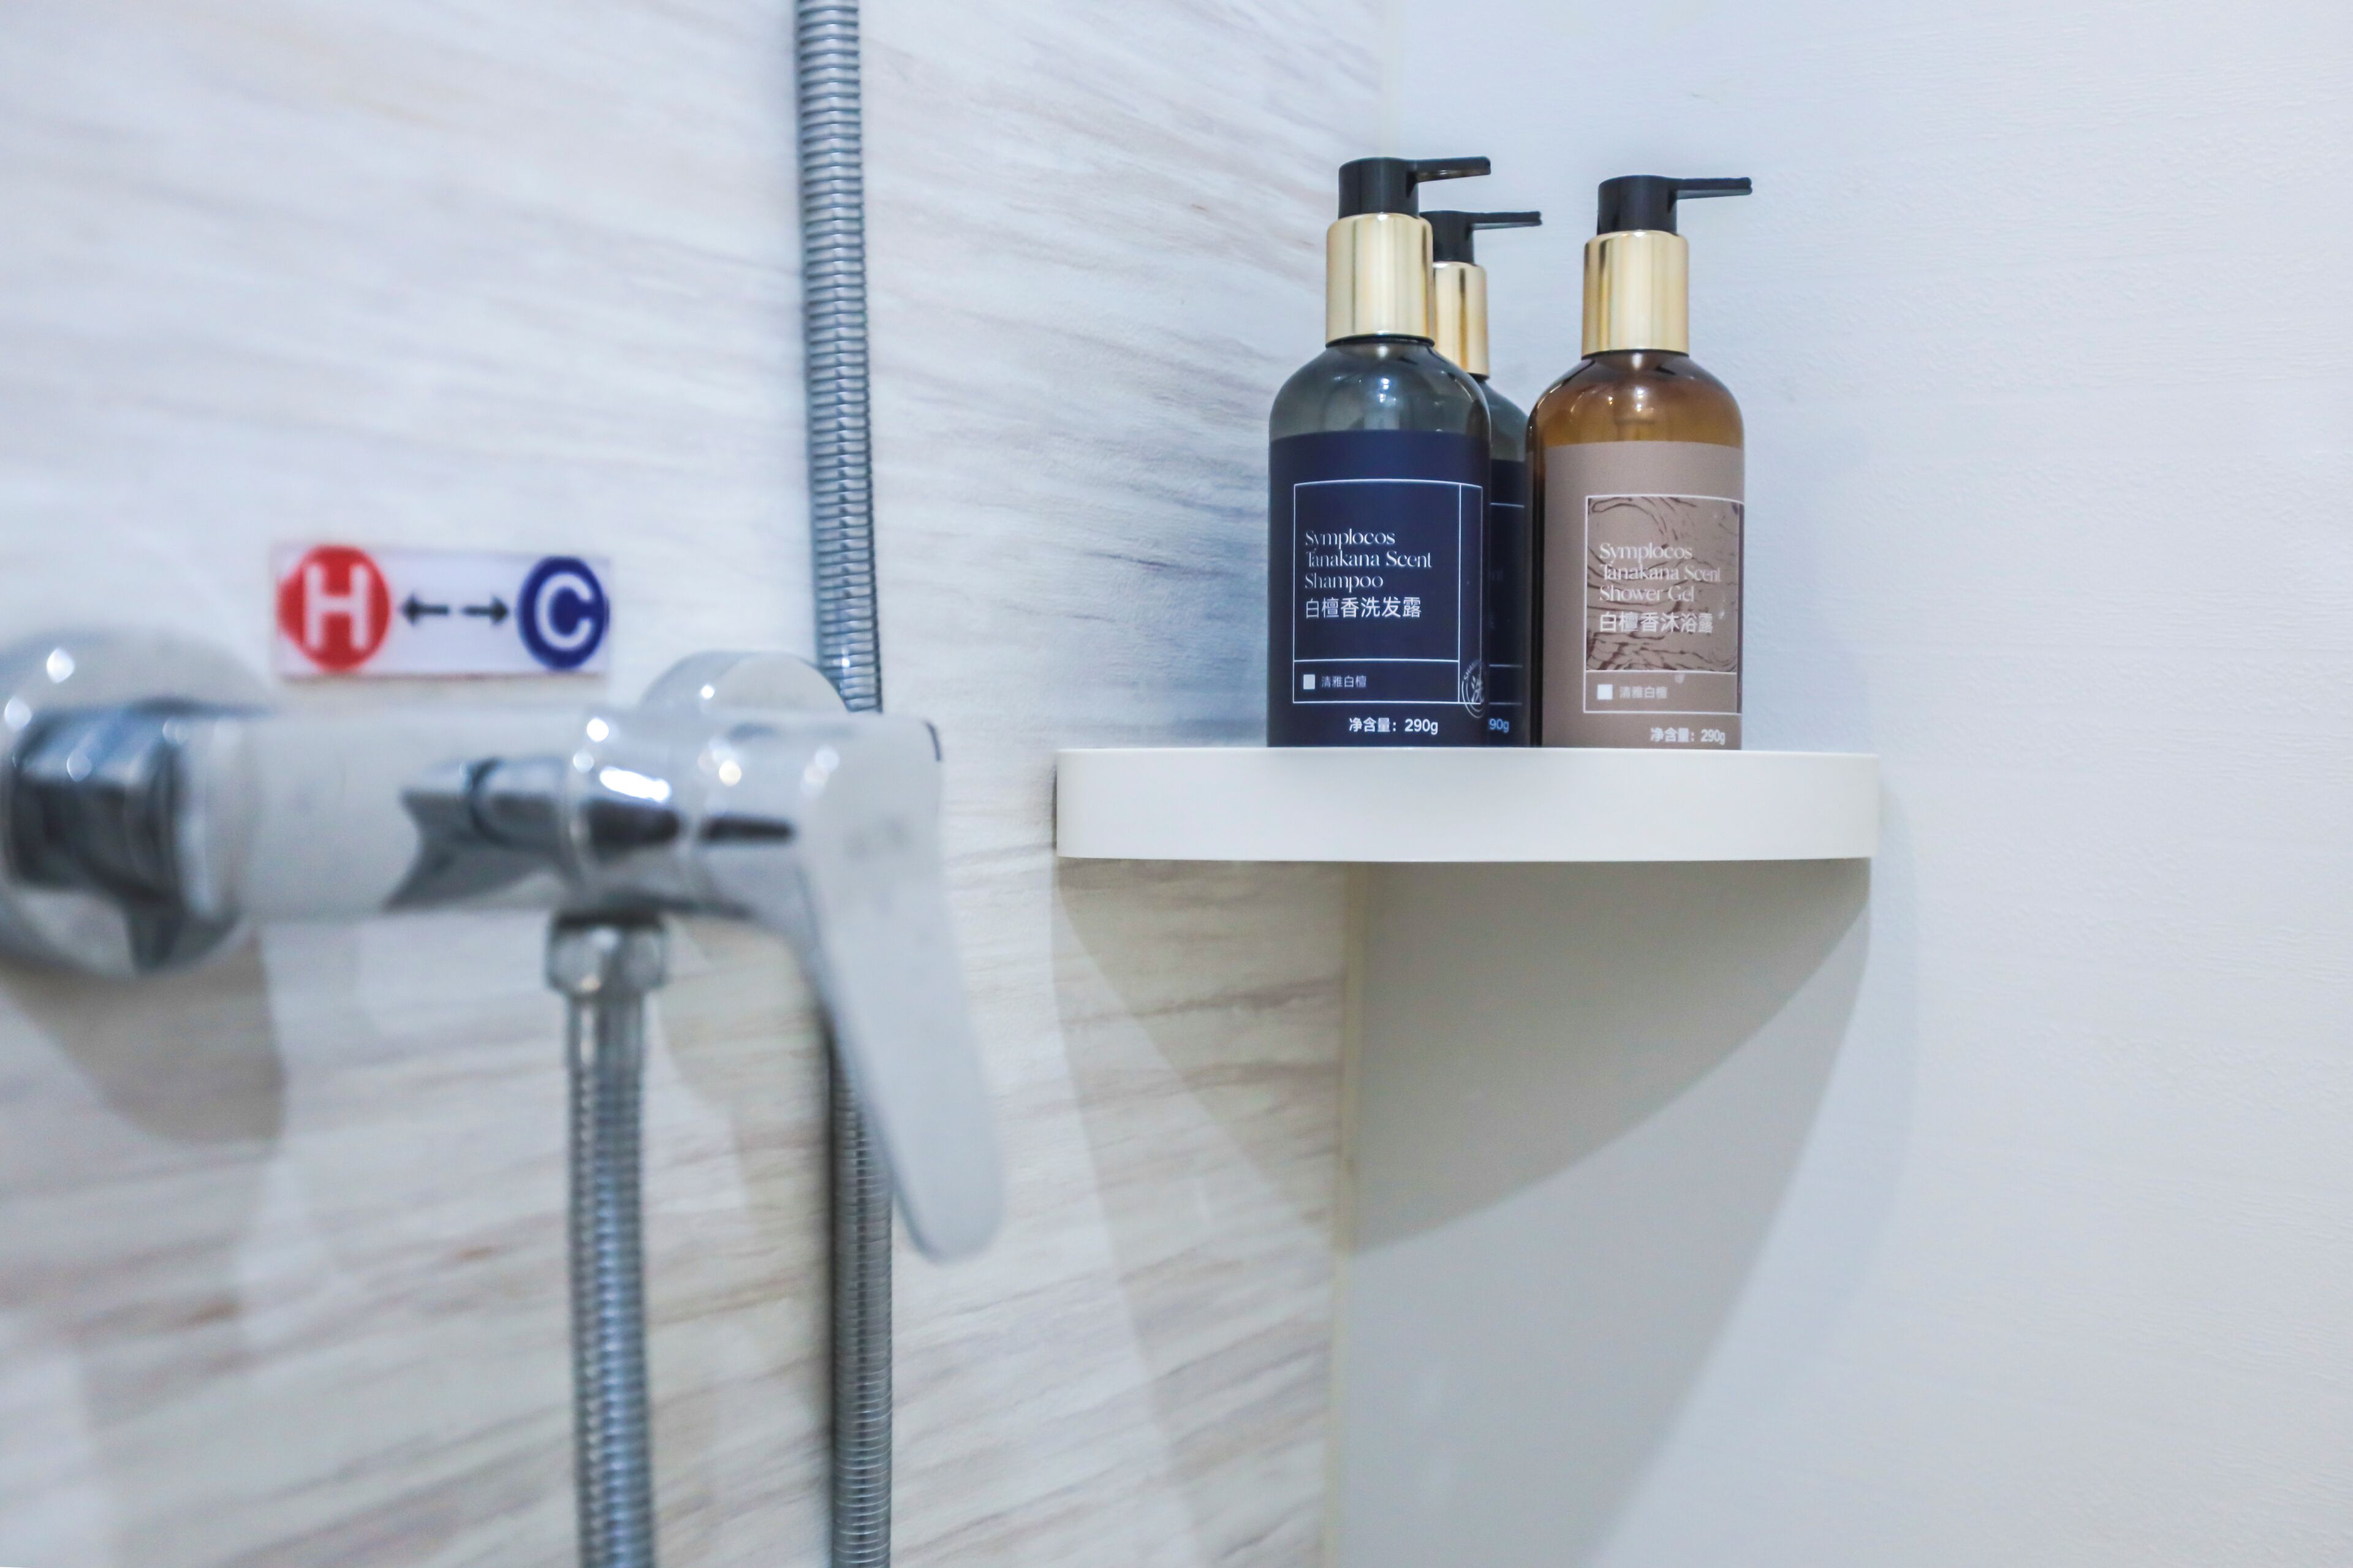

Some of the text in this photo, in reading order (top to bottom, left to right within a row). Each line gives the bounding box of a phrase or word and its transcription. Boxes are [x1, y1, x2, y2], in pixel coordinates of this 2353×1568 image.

[1306, 528, 1395, 550] Symplocos
[1306, 550, 1432, 567] Tanakana Scent
[1599, 542, 1693, 563] Symplocos
[1305, 572, 1384, 593] Shampoo
[1600, 564, 1721, 581] Tanakana Scent
[1599, 585, 1694, 602] Shower Gel
[307, 562, 594, 652] H C
[1306, 596, 1422, 618] 白檀香洗发露
[1600, 612, 1713, 633] 白檀香沐浴露
[1321, 675, 1366, 687] 清雅白檀
[1489, 718, 1509, 733] 90g
